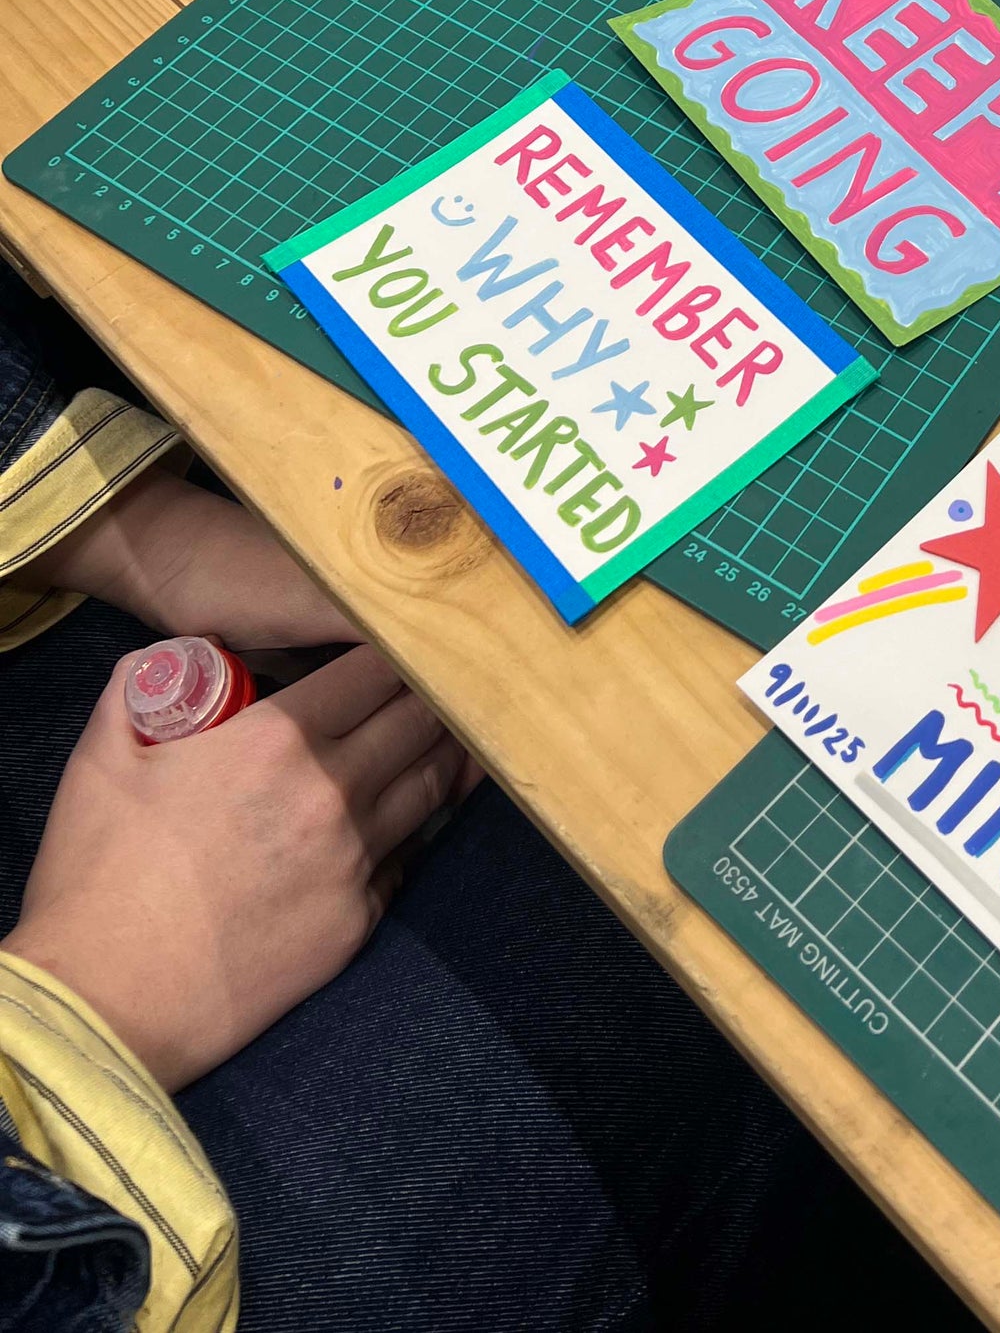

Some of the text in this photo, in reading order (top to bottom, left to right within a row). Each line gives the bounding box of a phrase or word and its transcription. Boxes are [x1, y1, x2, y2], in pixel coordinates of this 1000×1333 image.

[673, 16, 967, 275] GOING
[455, 215, 631, 380] WHY
[494, 124, 784, 407] REMEMBER
[331, 223, 642, 554] YOU STARTED
[683, 543, 807, 622] 24 25 26 27
[765, 663, 866, 763] 9/11/25
[713, 856, 889, 1035] CUTTING MAT 4530
